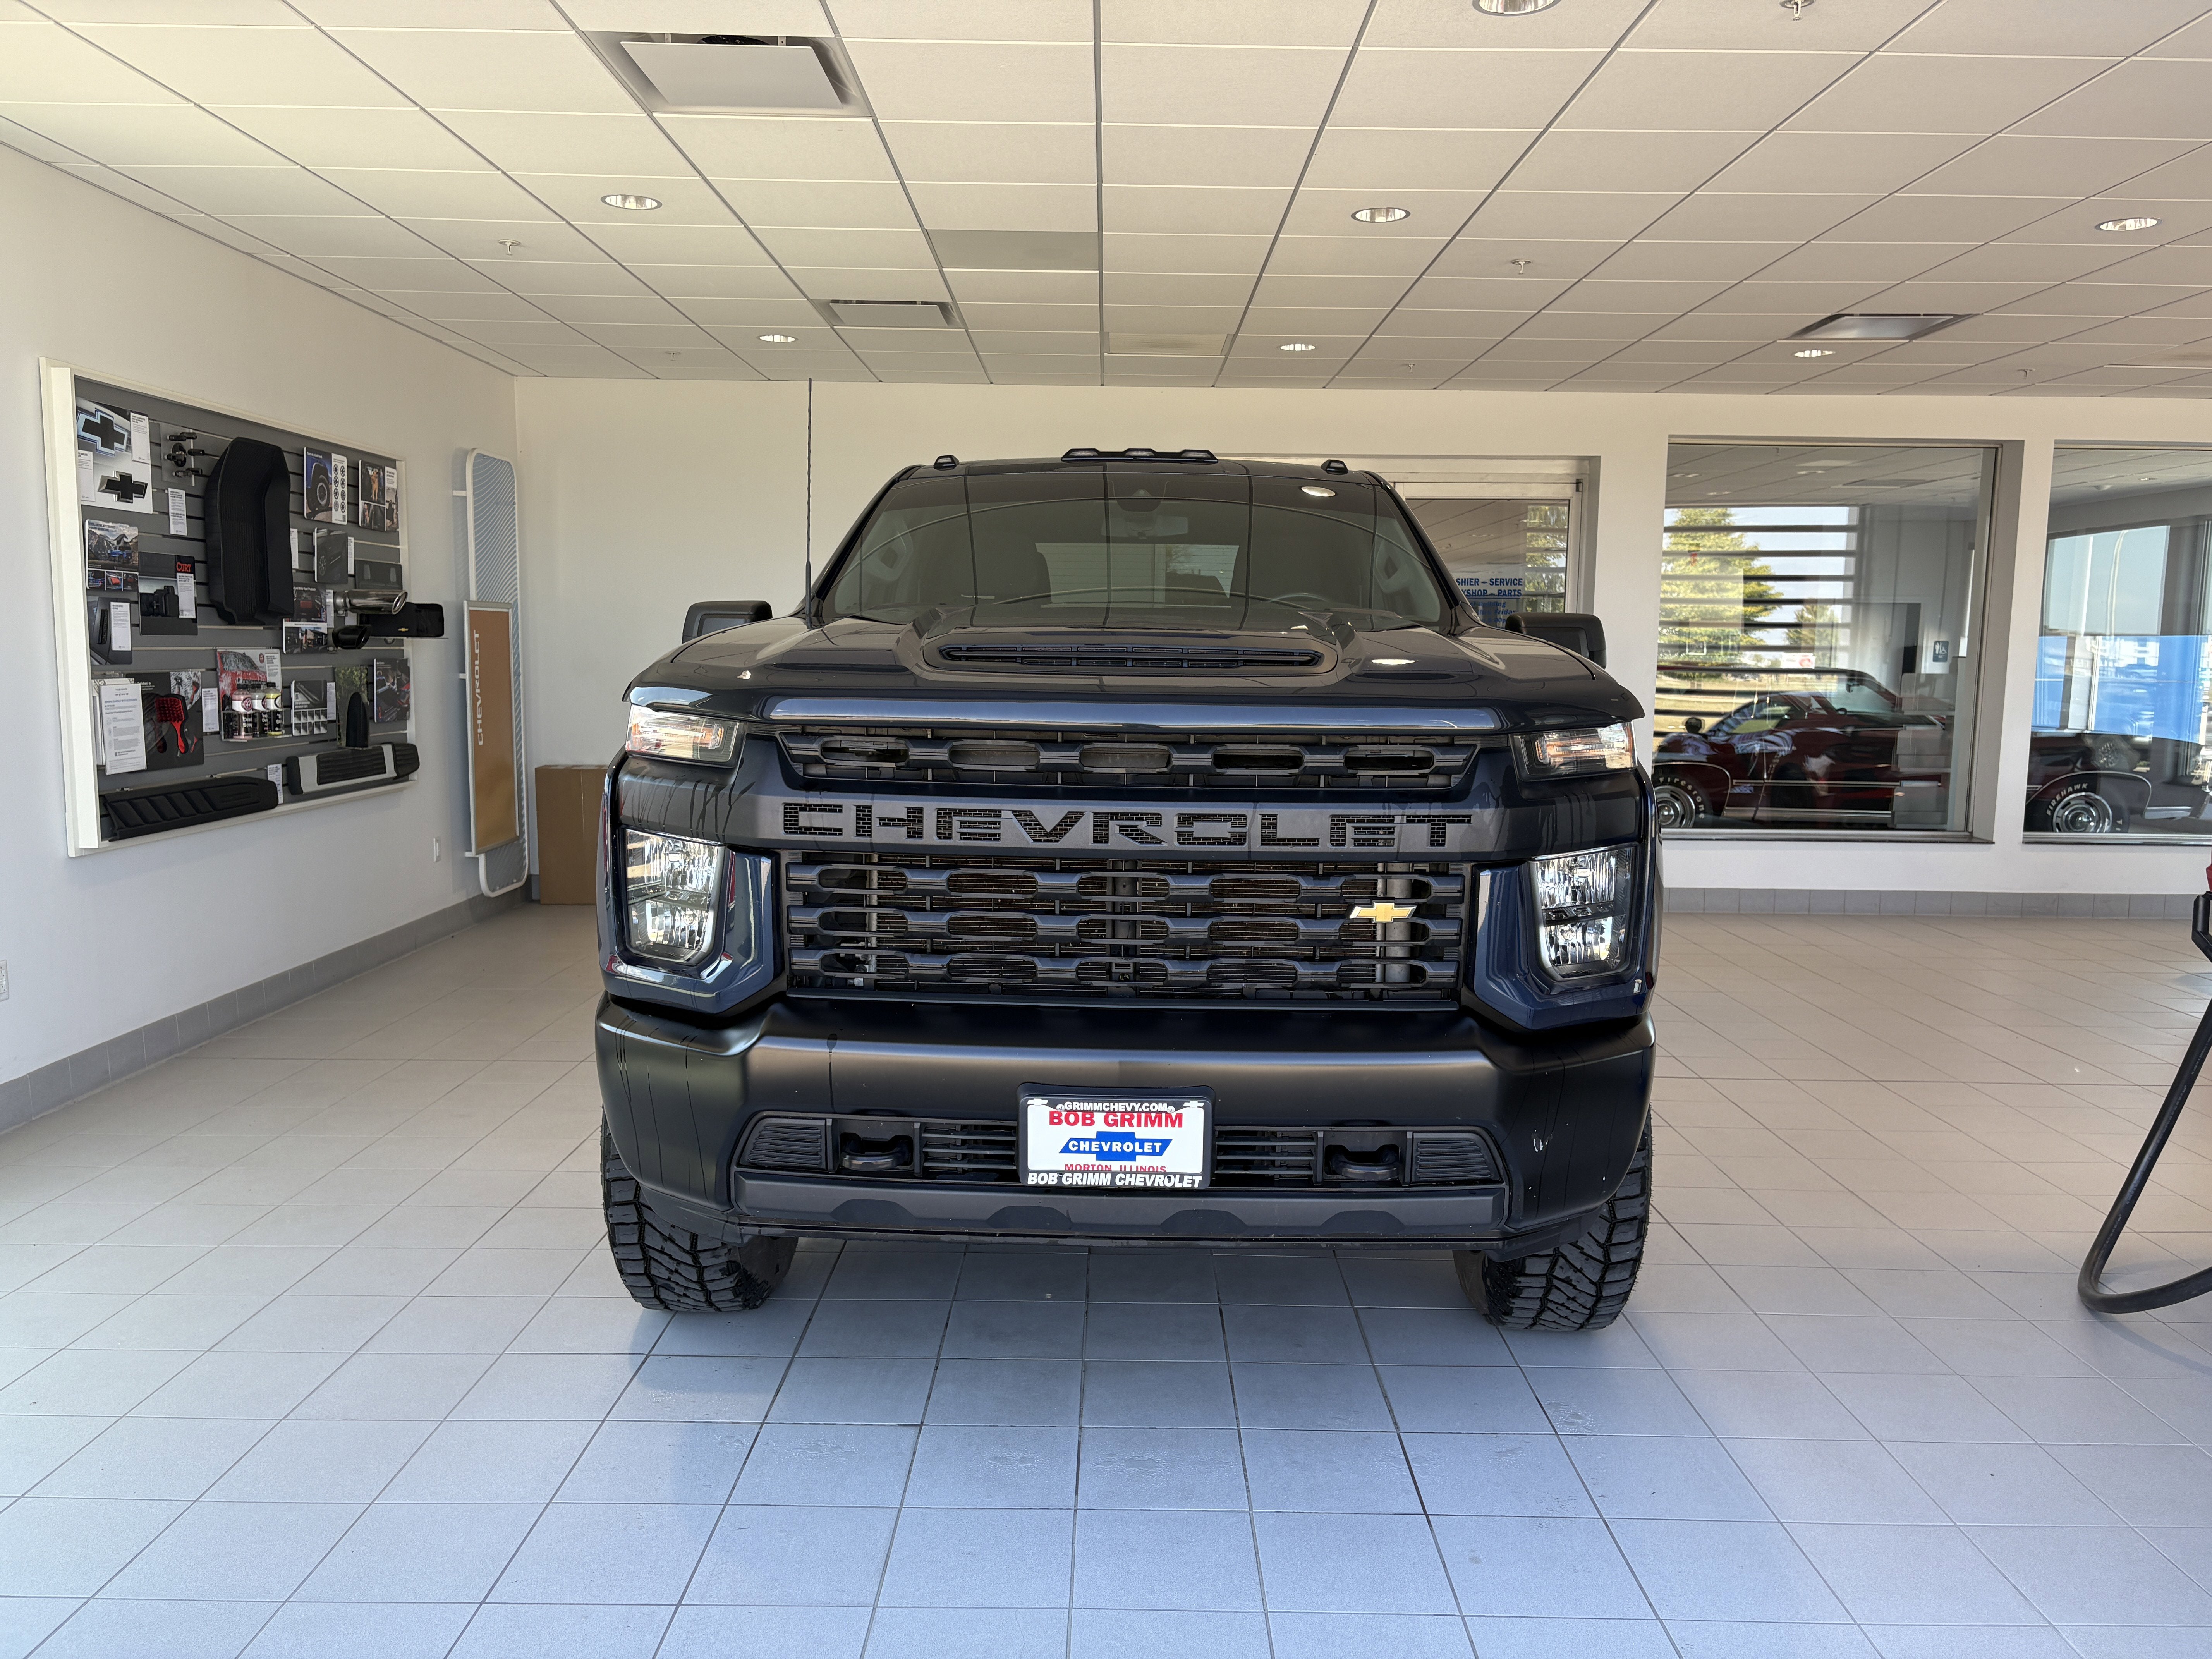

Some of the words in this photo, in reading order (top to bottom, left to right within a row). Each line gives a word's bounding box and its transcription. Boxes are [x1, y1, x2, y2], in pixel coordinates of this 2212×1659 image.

[177, 562, 192, 572] CURT
[1456, 578, 1480, 586] SHIER
[1489, 578, 1523, 586] SERVICE
[474, 629, 483, 745] CHEVROLET
[1659, 776, 1705, 819] Firestone
[2046, 783, 2089, 816] FIREHAWK
[783, 802, 1472, 847] CHEVROLET
[1065, 1101, 1168, 1112] GRIMMCHEVY.COM
[1049, 1111, 1095, 1126] BOB
[1103, 1112, 1183, 1128] GRIMM
[1068, 1140, 1162, 1152] CHEVROLET
[1027, 1172, 1058, 1185] BOB
[1061, 1173, 1111, 1186] GRIMM
[1115, 1173, 1202, 1188] CHEVROLET
